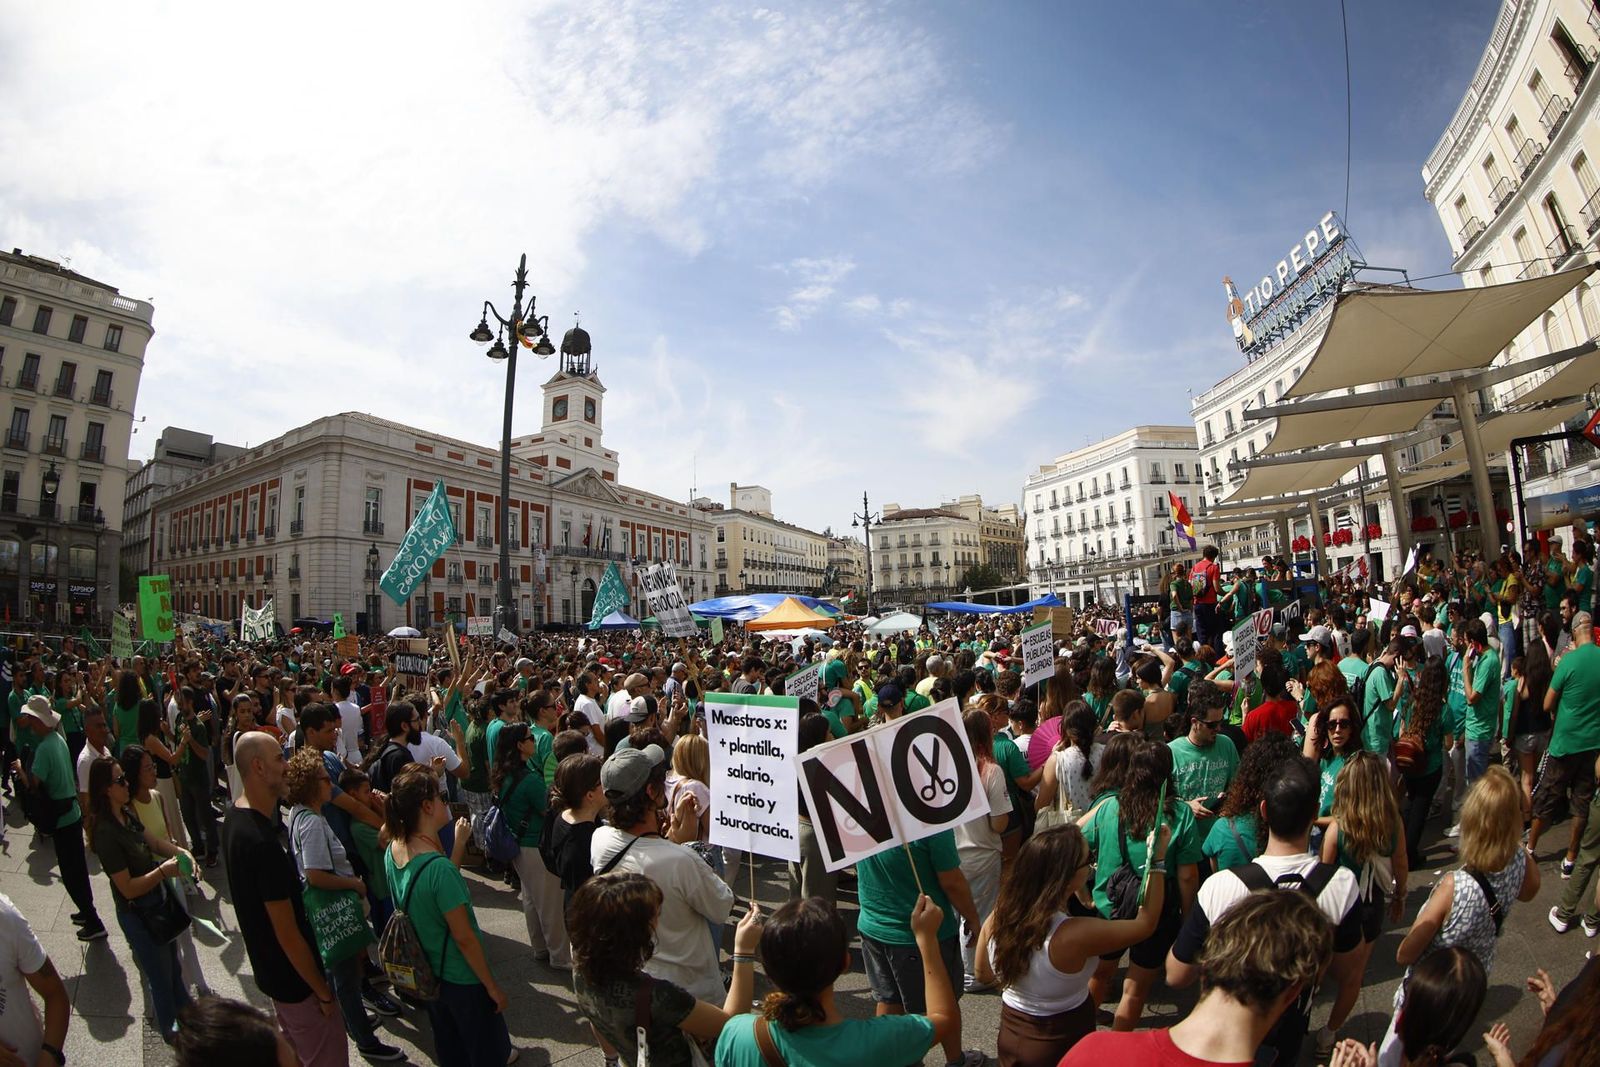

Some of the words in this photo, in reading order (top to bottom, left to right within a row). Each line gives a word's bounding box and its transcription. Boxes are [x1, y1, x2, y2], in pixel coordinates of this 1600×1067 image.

[1244, 276, 1272, 314] TIO
[1276, 210, 1340, 286] PEPE
[31, 582, 56, 590] ZAPSOP
[642, 568, 676, 592] NETANYAHU
[648, 591, 685, 612] GENOCIDA
[1030, 629, 1051, 646] ESCUELAS
[1097, 620, 1118, 634] NO
[1026, 643, 1052, 662] PÚBLICAS
[794, 668, 818, 688] ESCUELAS
[712, 710, 770, 728] Maestros
[774, 719, 787, 730] x:
[720, 738, 726, 747] +
[729, 737, 784, 760] plantilla,
[728, 764, 774, 786] salario,
[802, 715, 972, 862] NO
[734, 792, 765, 808] ratio
[768, 800, 776, 814] y
[715, 810, 793, 839] -burocracia.
